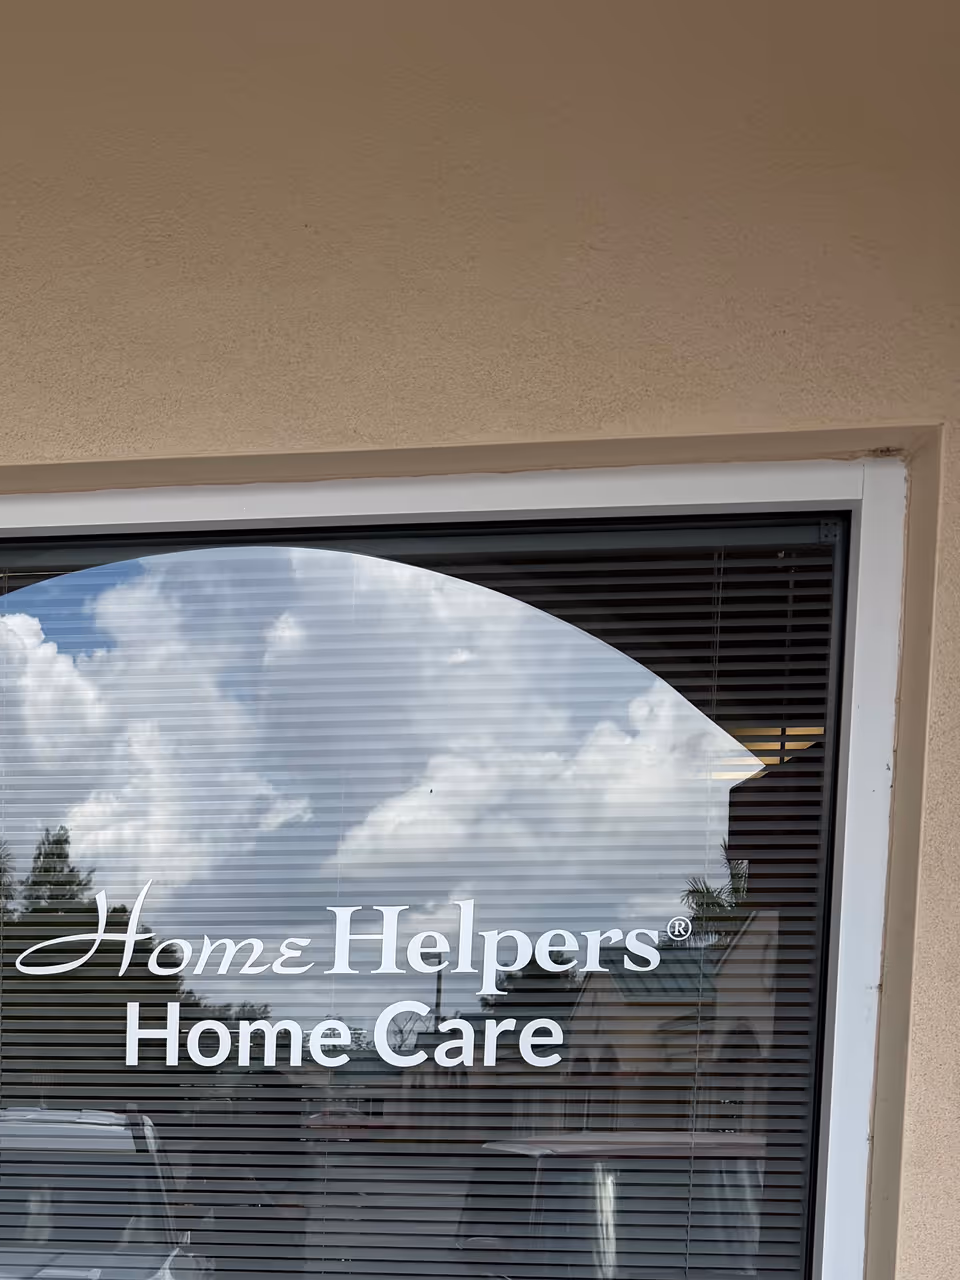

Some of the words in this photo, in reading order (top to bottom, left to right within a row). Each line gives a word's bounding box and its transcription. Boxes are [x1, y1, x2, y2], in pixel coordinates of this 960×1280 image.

[15, 877, 317, 978] Home
[125, 1001, 368, 1067] Home
[373, 1000, 565, 1068] Care
